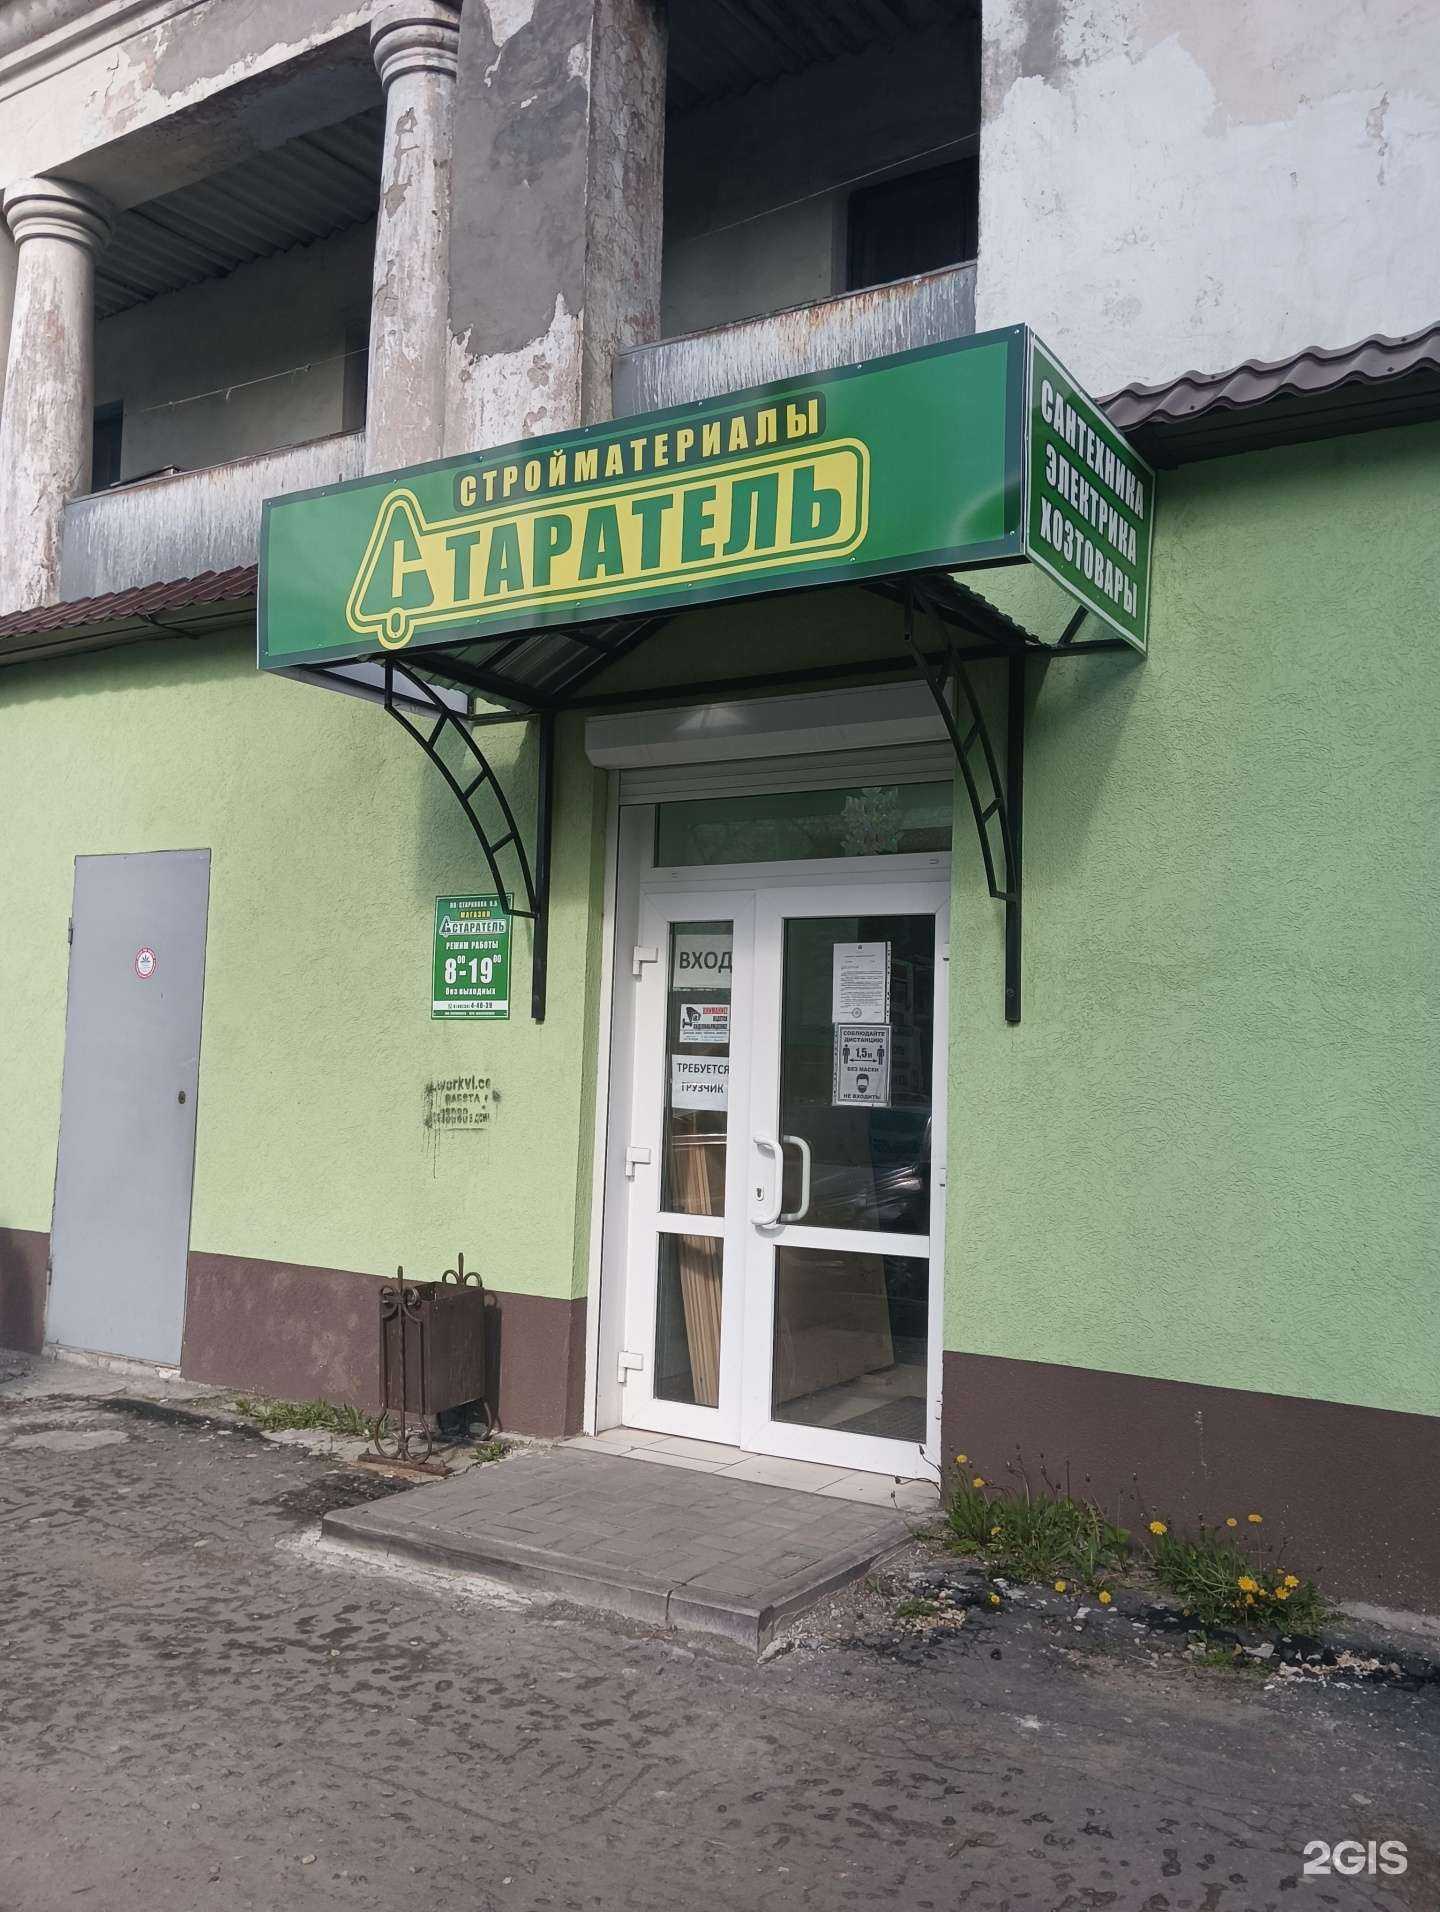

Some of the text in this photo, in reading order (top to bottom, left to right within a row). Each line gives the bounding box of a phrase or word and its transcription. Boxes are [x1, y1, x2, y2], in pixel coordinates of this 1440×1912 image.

[459, 398, 819, 507] СТРОЙМАТЕРИАЛЫ
[1041, 379, 1144, 520] САНТЕХНИКА
[1046, 443, 1137, 566] ЭЛЕКТРИКА
[1040, 496, 1137, 618] ХОЗТОВАРЫ
[452, 922, 504, 933] СТАРАТЕЛЬ
[446, 940, 499, 950] РЕЖИМ РАБОТЫ
[679, 951, 733, 973] ВХОД
[677, 1062, 730, 1075] ТРЕБУЕТСЯ
[681, 1081, 724, 1094] ГРУЗЧИК
